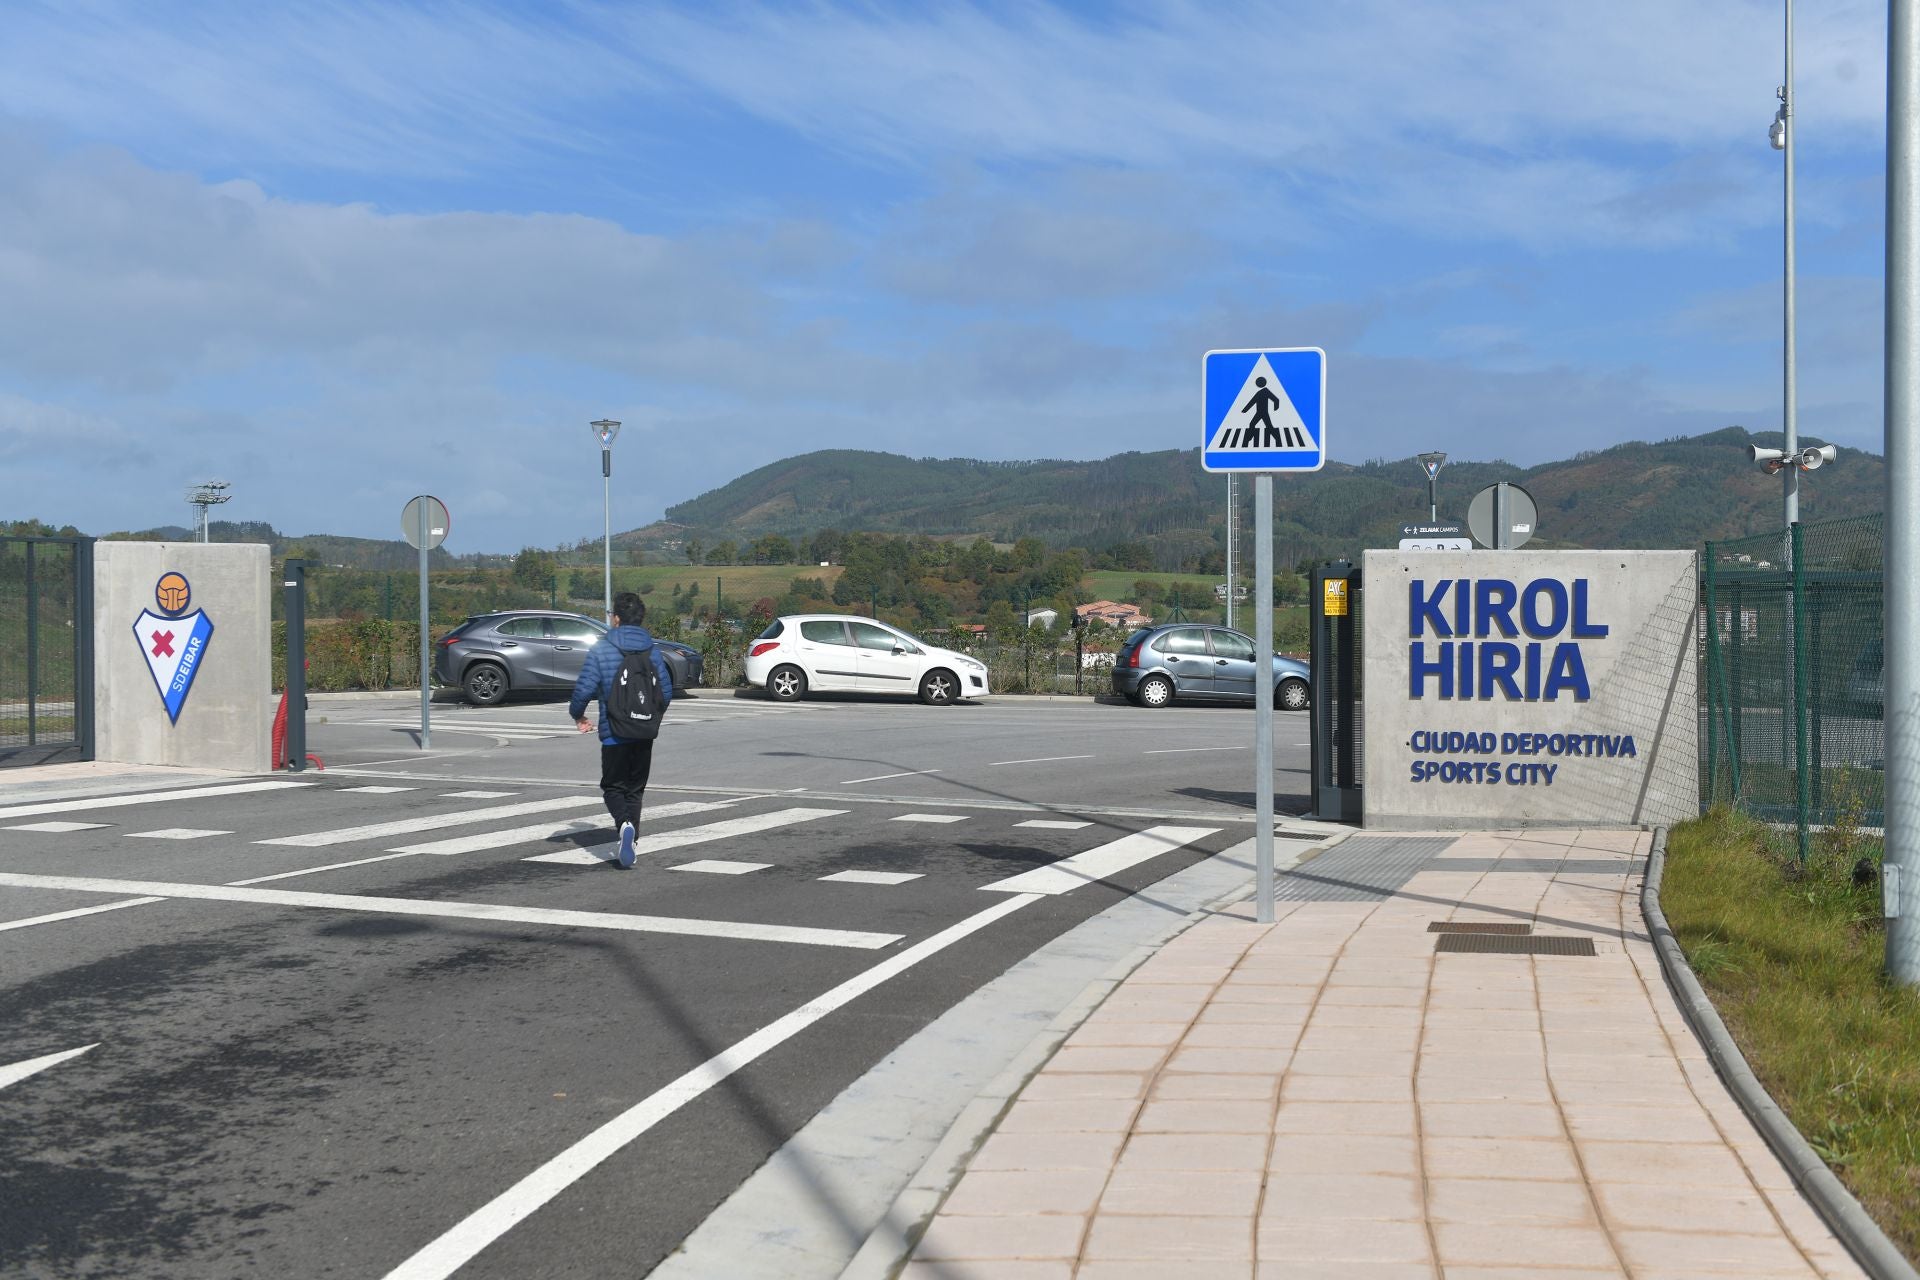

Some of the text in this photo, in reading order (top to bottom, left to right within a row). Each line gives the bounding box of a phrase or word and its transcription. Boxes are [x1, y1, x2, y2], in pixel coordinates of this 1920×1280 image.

[1411, 578, 1609, 638] KIROL
[1411, 641, 1591, 700] HIRIA
[1410, 730, 1637, 758] CIUDAD DEPORTIVA
[1410, 760, 1558, 785] SPORTS CITY
